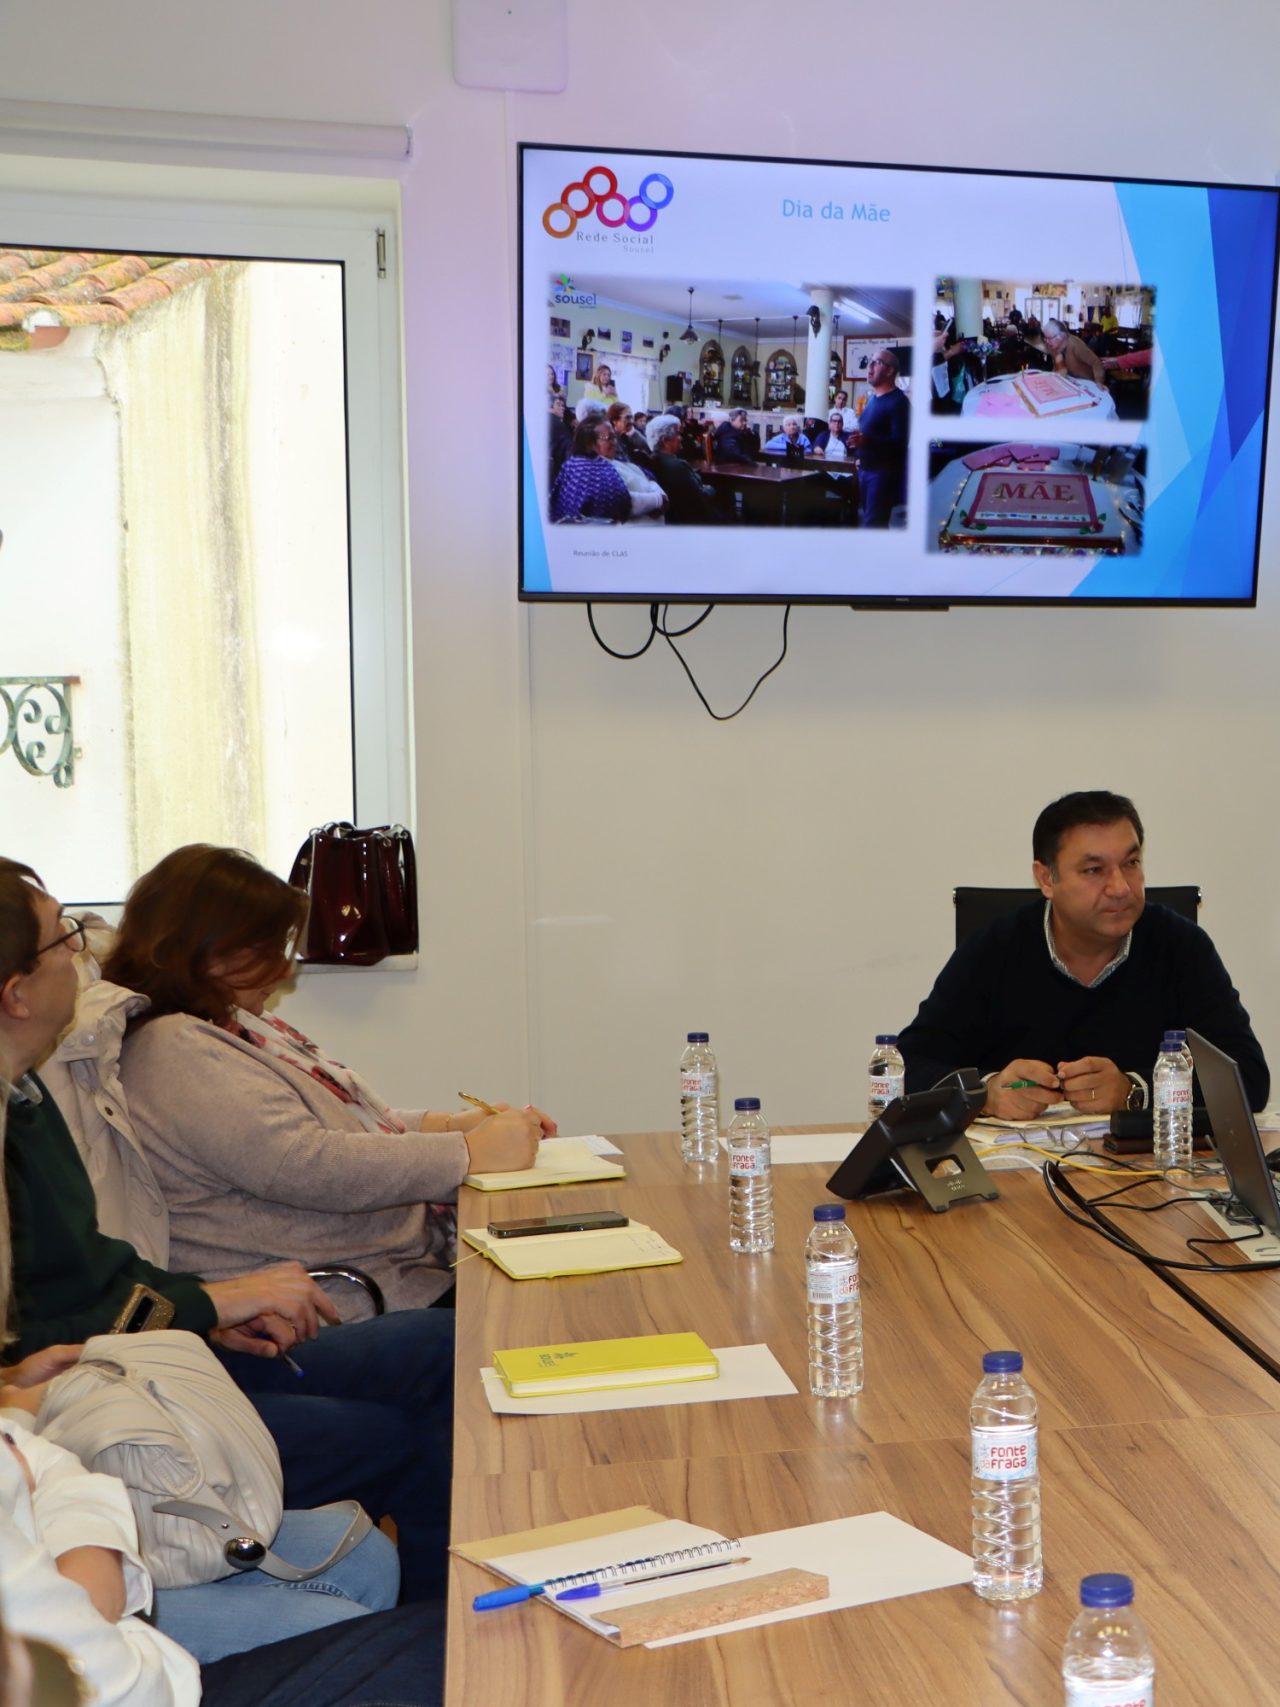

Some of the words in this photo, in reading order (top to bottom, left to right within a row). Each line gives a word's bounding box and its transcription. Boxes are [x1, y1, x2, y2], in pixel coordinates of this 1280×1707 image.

[782, 199, 813, 218] Dia
[820, 201, 844, 220] da
[851, 203, 891, 222] Mãe
[576, 231, 608, 243] Rede
[613, 233, 654, 245] Social
[555, 293, 597, 305] sousel
[1000, 480, 1075, 501] MÃE
